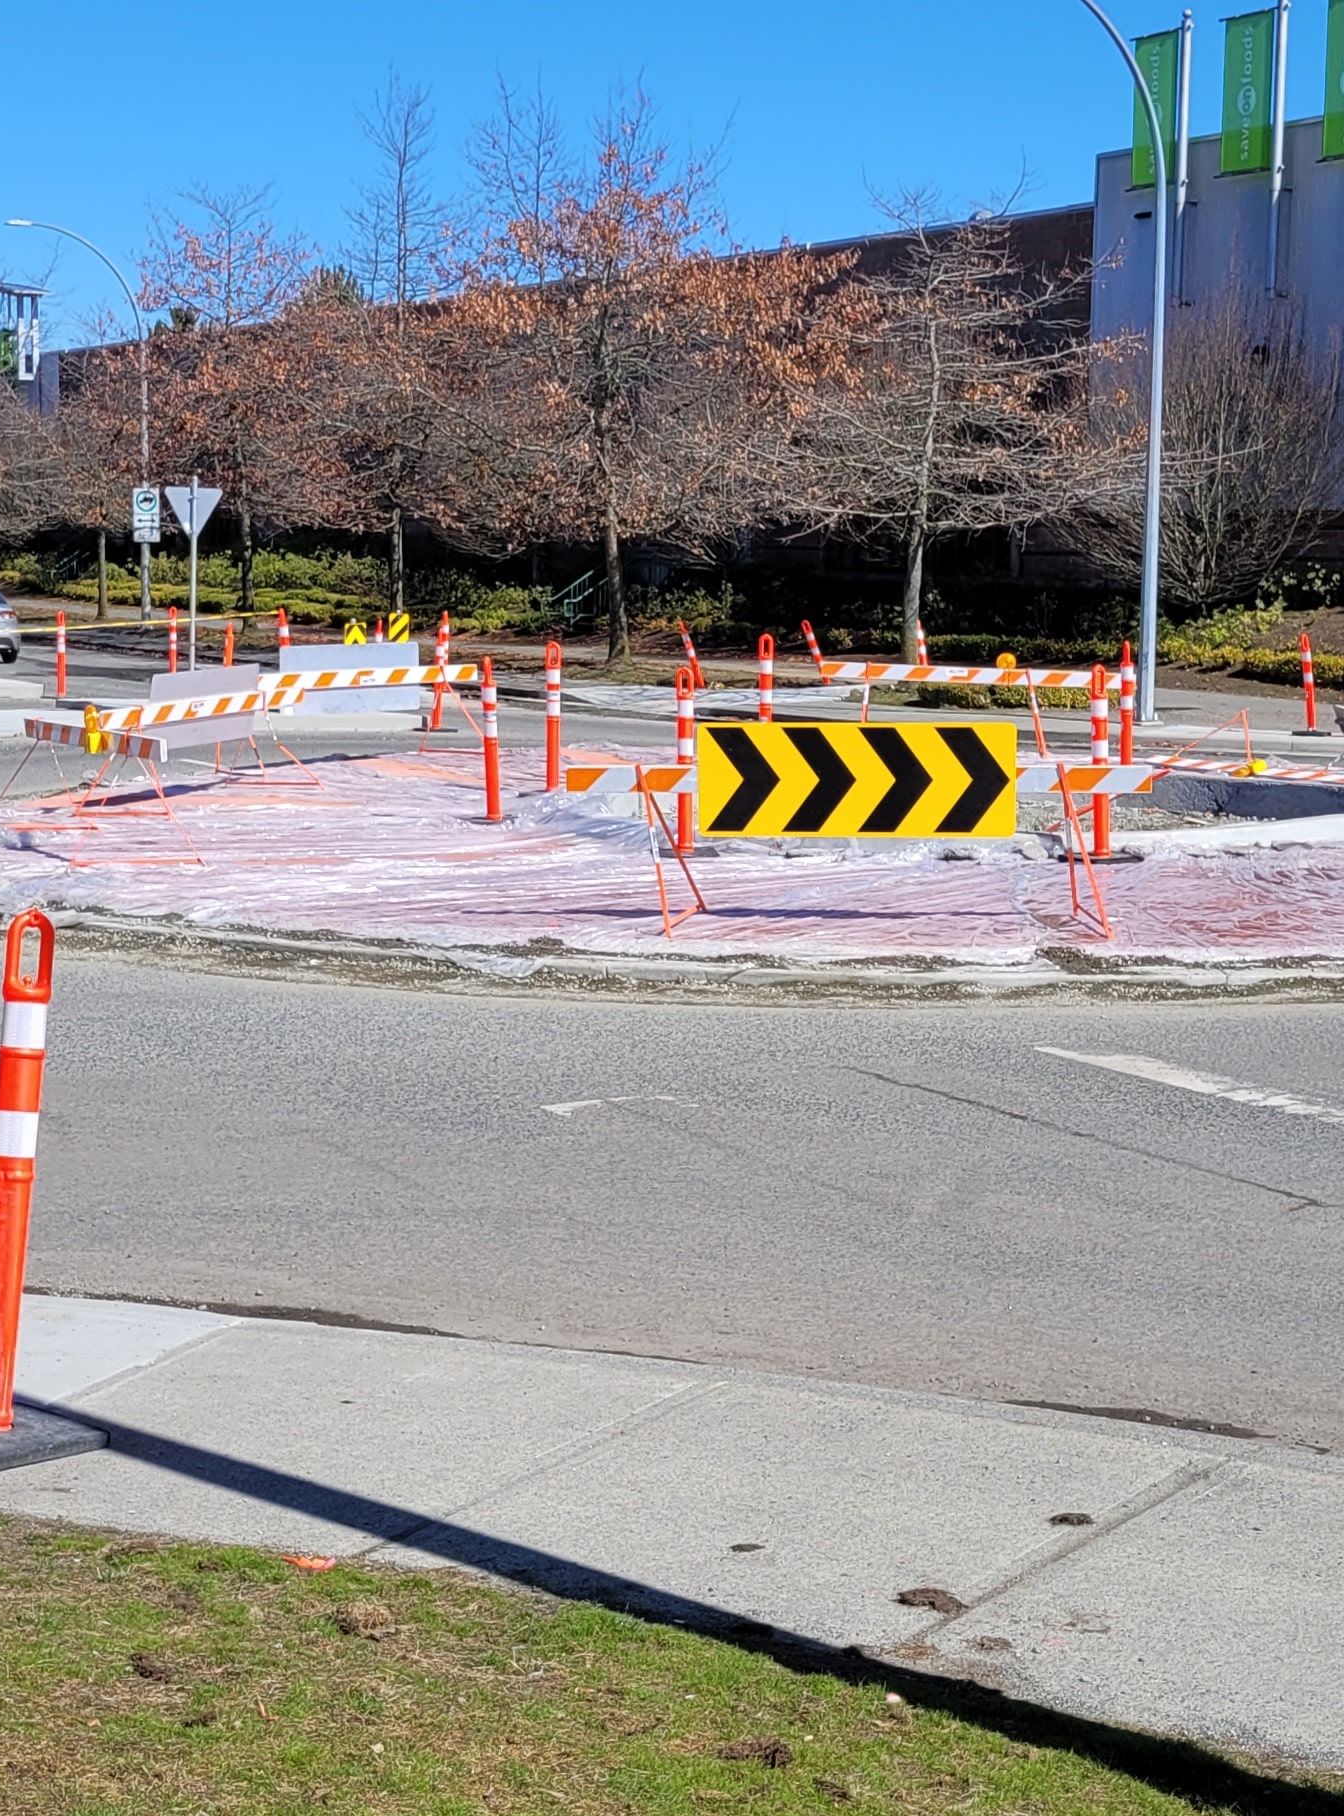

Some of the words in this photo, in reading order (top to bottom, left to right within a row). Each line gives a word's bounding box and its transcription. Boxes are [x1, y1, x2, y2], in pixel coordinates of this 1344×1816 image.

[1240, 25, 1255, 83] foods
[1241, 88, 1252, 111] on
[1240, 117, 1251, 161] save
